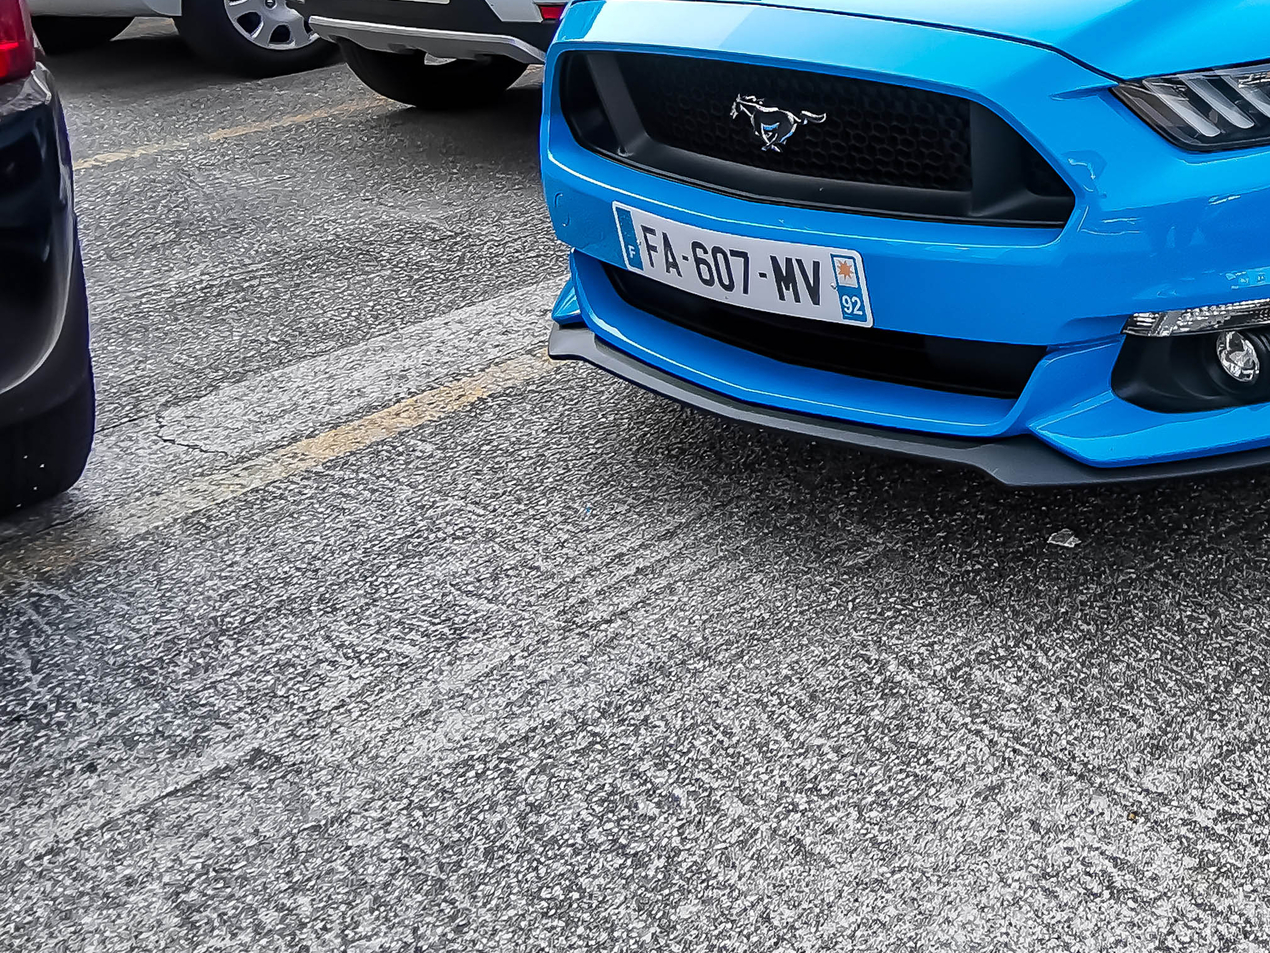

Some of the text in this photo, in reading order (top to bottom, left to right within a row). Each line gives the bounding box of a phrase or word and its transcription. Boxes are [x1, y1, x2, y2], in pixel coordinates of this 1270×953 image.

[627, 225, 863, 316] F FA-607-MV 92
